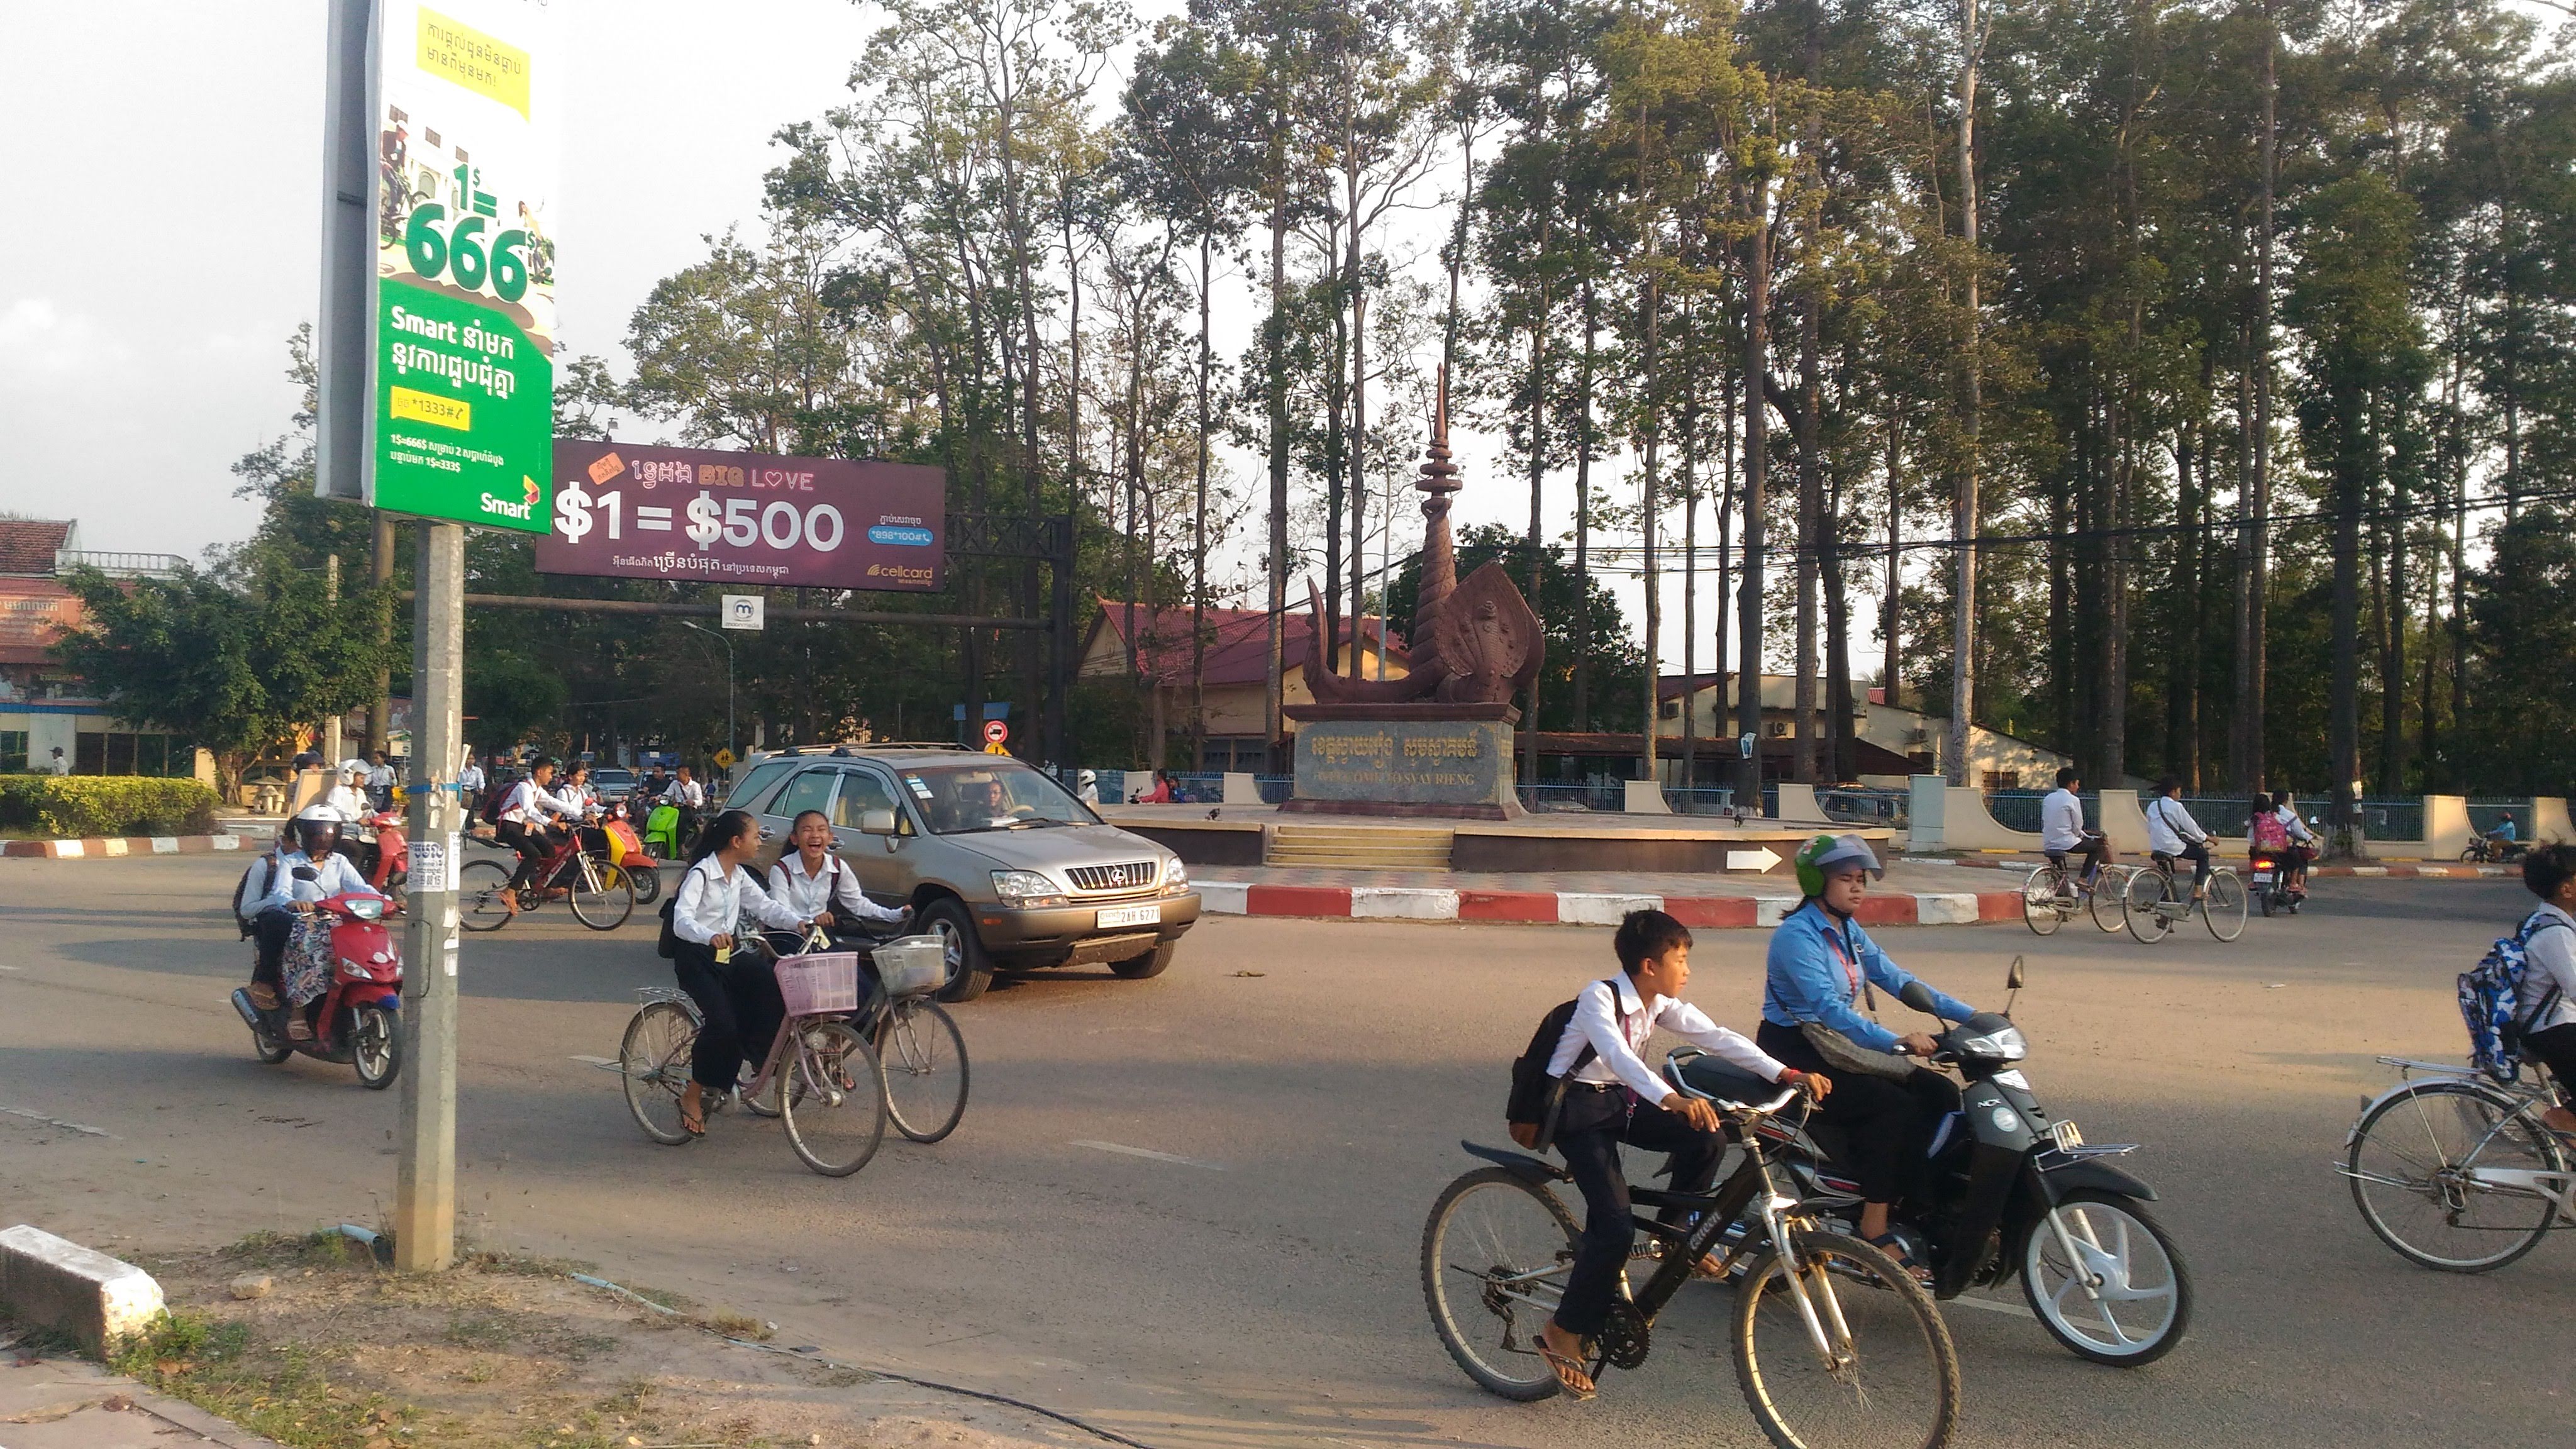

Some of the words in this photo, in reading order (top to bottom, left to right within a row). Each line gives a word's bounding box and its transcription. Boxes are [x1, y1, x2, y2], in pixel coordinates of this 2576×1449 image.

[391, 306, 458, 344] Smart
[463, 319, 514, 360] នាំមក
[455, 447, 462, 457] 2
[425, 457, 461, 473] 1$=333$
[699, 464, 744, 488] BIG
[480, 492, 531, 521] Smart
[554, 481, 621, 544] $1
[686, 490, 845, 552] $500
[880, 565, 933, 579] cellcard
[1404, 772, 1431, 785] SVAY
[1436, 773, 1475, 786] RIENG
